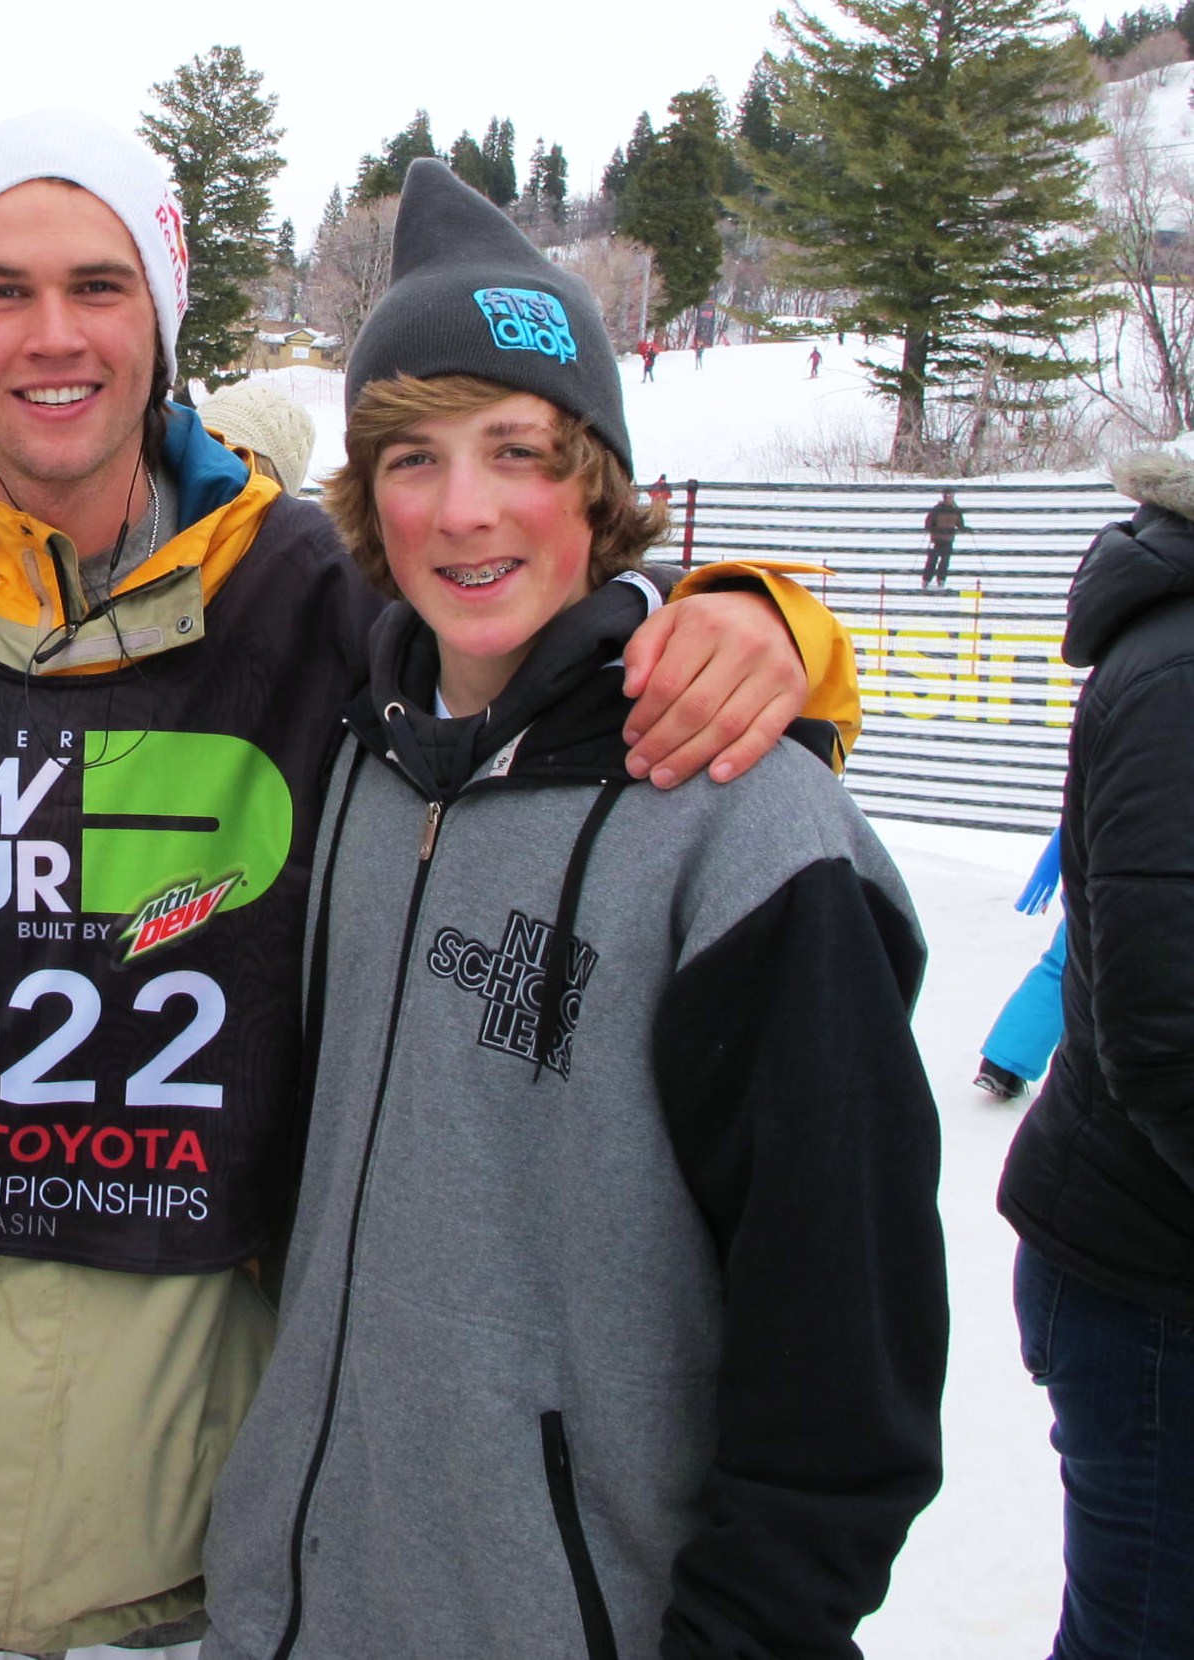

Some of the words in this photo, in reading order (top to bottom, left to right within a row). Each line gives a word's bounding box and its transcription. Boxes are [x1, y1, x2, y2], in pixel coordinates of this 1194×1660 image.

[496, 312, 577, 365] drop
[18, 922, 77, 940] BUILT
[83, 922, 111, 941] BY
